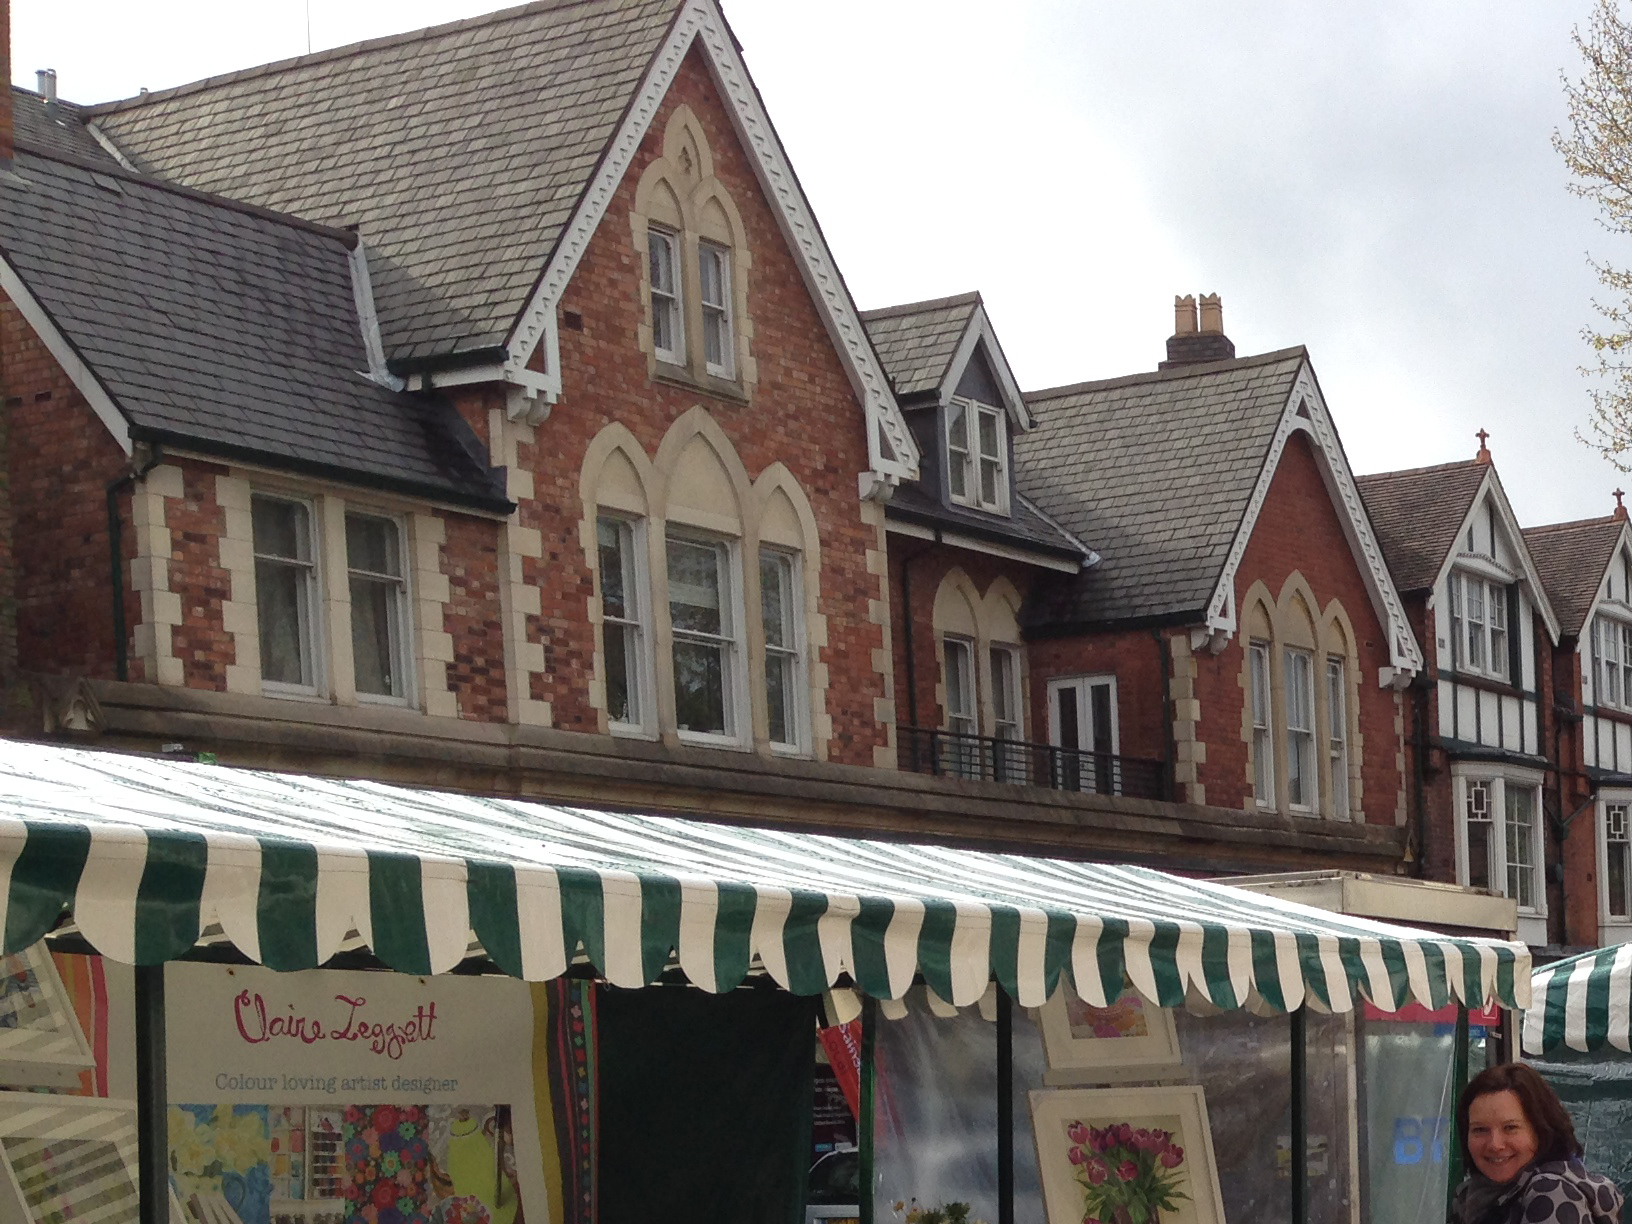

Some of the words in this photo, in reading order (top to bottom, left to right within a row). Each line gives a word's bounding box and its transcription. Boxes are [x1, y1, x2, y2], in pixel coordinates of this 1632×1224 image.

[234, 989, 326, 1043] Claire
[331, 995, 438, 1060] Leggett
[215, 1073, 278, 1091] Colour
[282, 1073, 337, 1093] loving
[341, 1075, 388, 1091] artist
[391, 1075, 459, 1094] designer
